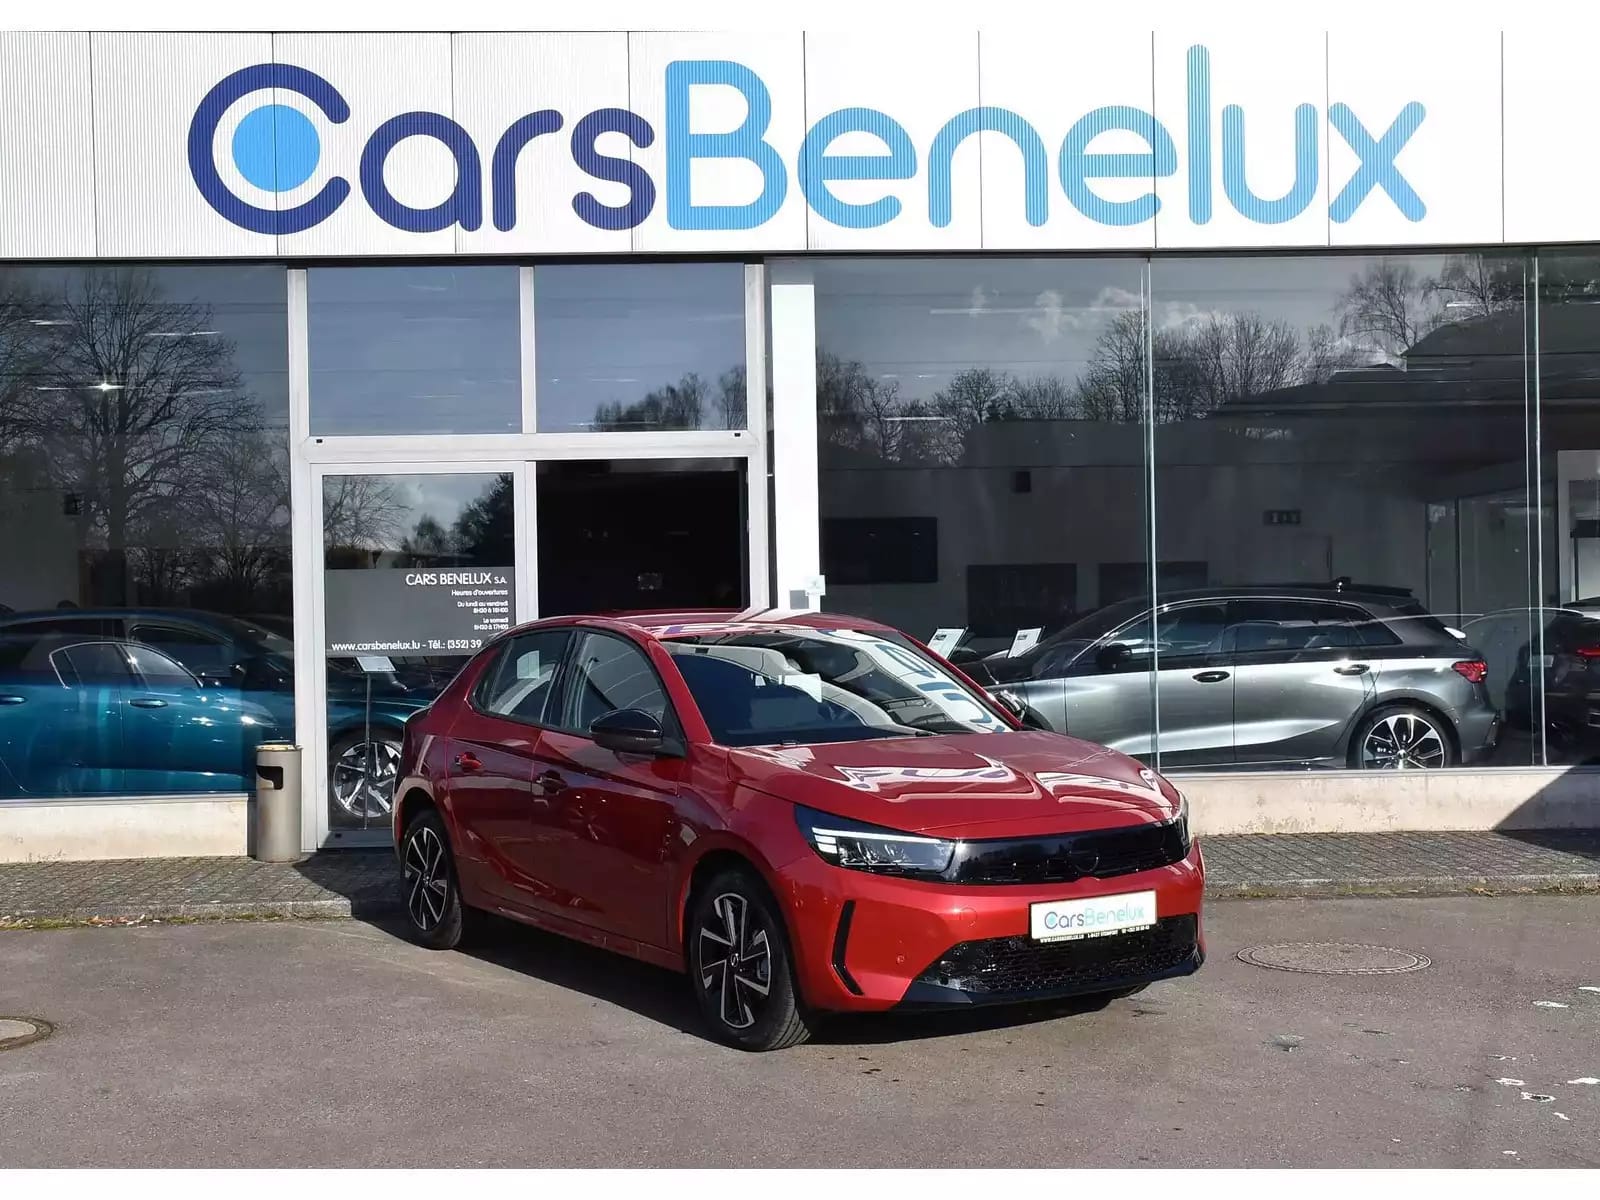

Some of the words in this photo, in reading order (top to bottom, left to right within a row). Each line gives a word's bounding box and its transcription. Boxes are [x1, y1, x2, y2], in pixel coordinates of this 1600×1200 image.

[188, 44, 1426, 235] CarsBenelux
[406, 573, 438, 586] CARS
[440, 573, 491, 585] BENELUX
[494, 576, 508, 584] S.A.
[332, 640, 420, 651] www.carsbenelux.lu
[447, 640, 469, 650] (352)
[470, 640, 482, 649] 39
[1044, 903, 1144, 930] CarsBenelux
